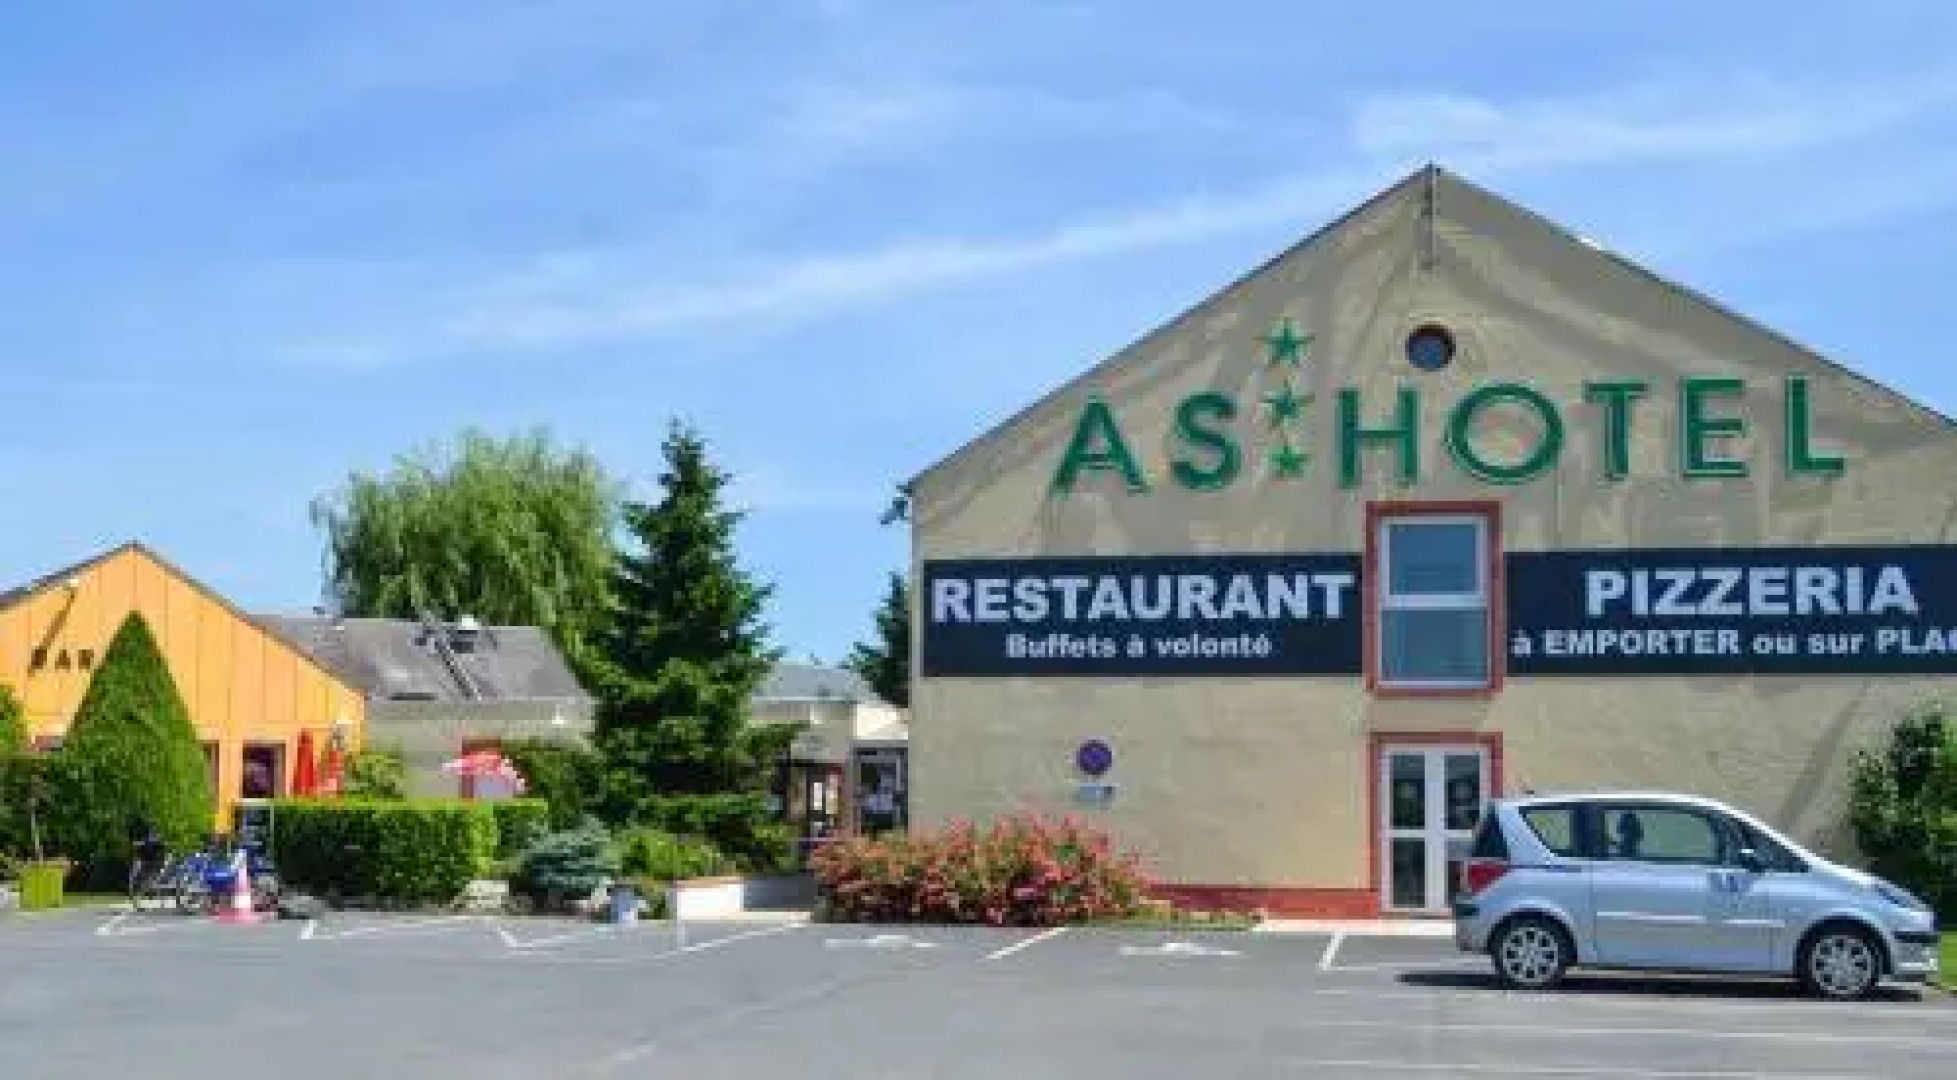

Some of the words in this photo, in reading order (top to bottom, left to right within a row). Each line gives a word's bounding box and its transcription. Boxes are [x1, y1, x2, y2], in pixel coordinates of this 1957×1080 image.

[1051, 391, 1242, 495] AS
[1335, 373, 1847, 488] HOTEL
[931, 573, 1355, 623] RESTAURANT
[1585, 565, 1919, 615] PIZZERIA
[1005, 633, 1116, 658] Buffets
[1156, 633, 1272, 658] volonté
[1544, 629, 1740, 656] EMPORTER
[1753, 633, 1798, 655] ou
[1807, 633, 1865, 656] sur
